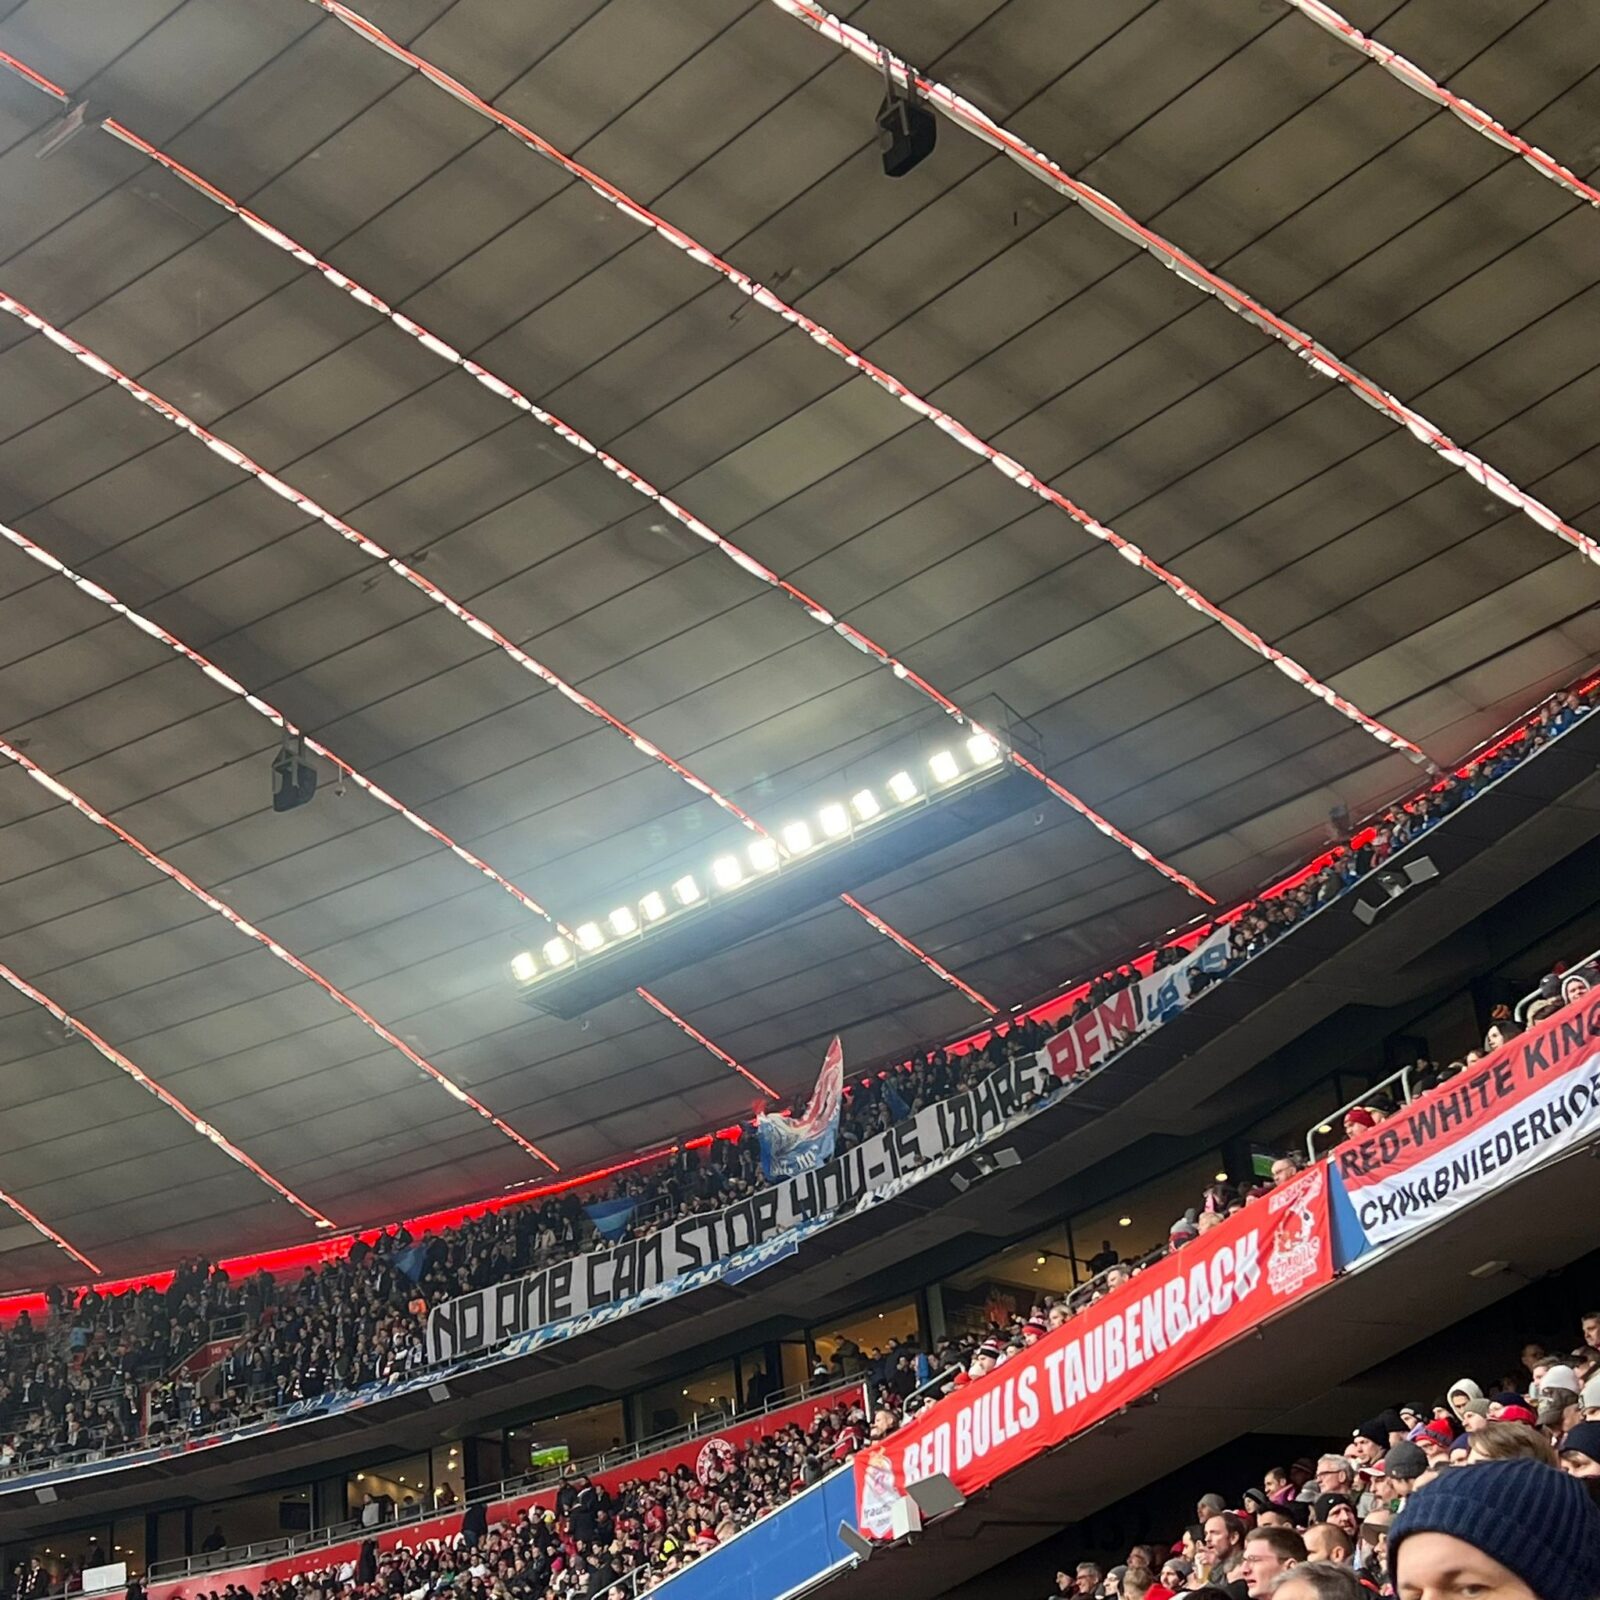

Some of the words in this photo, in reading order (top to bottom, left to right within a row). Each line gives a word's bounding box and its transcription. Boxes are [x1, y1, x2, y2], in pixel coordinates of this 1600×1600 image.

[1341, 1058, 1515, 1179] RED-WHITE
[433, 1293, 484, 1359] NO
[675, 1190, 778, 1274] STOP
[903, 1425, 952, 1488] RED
[953, 1373, 1040, 1470] BULLS
